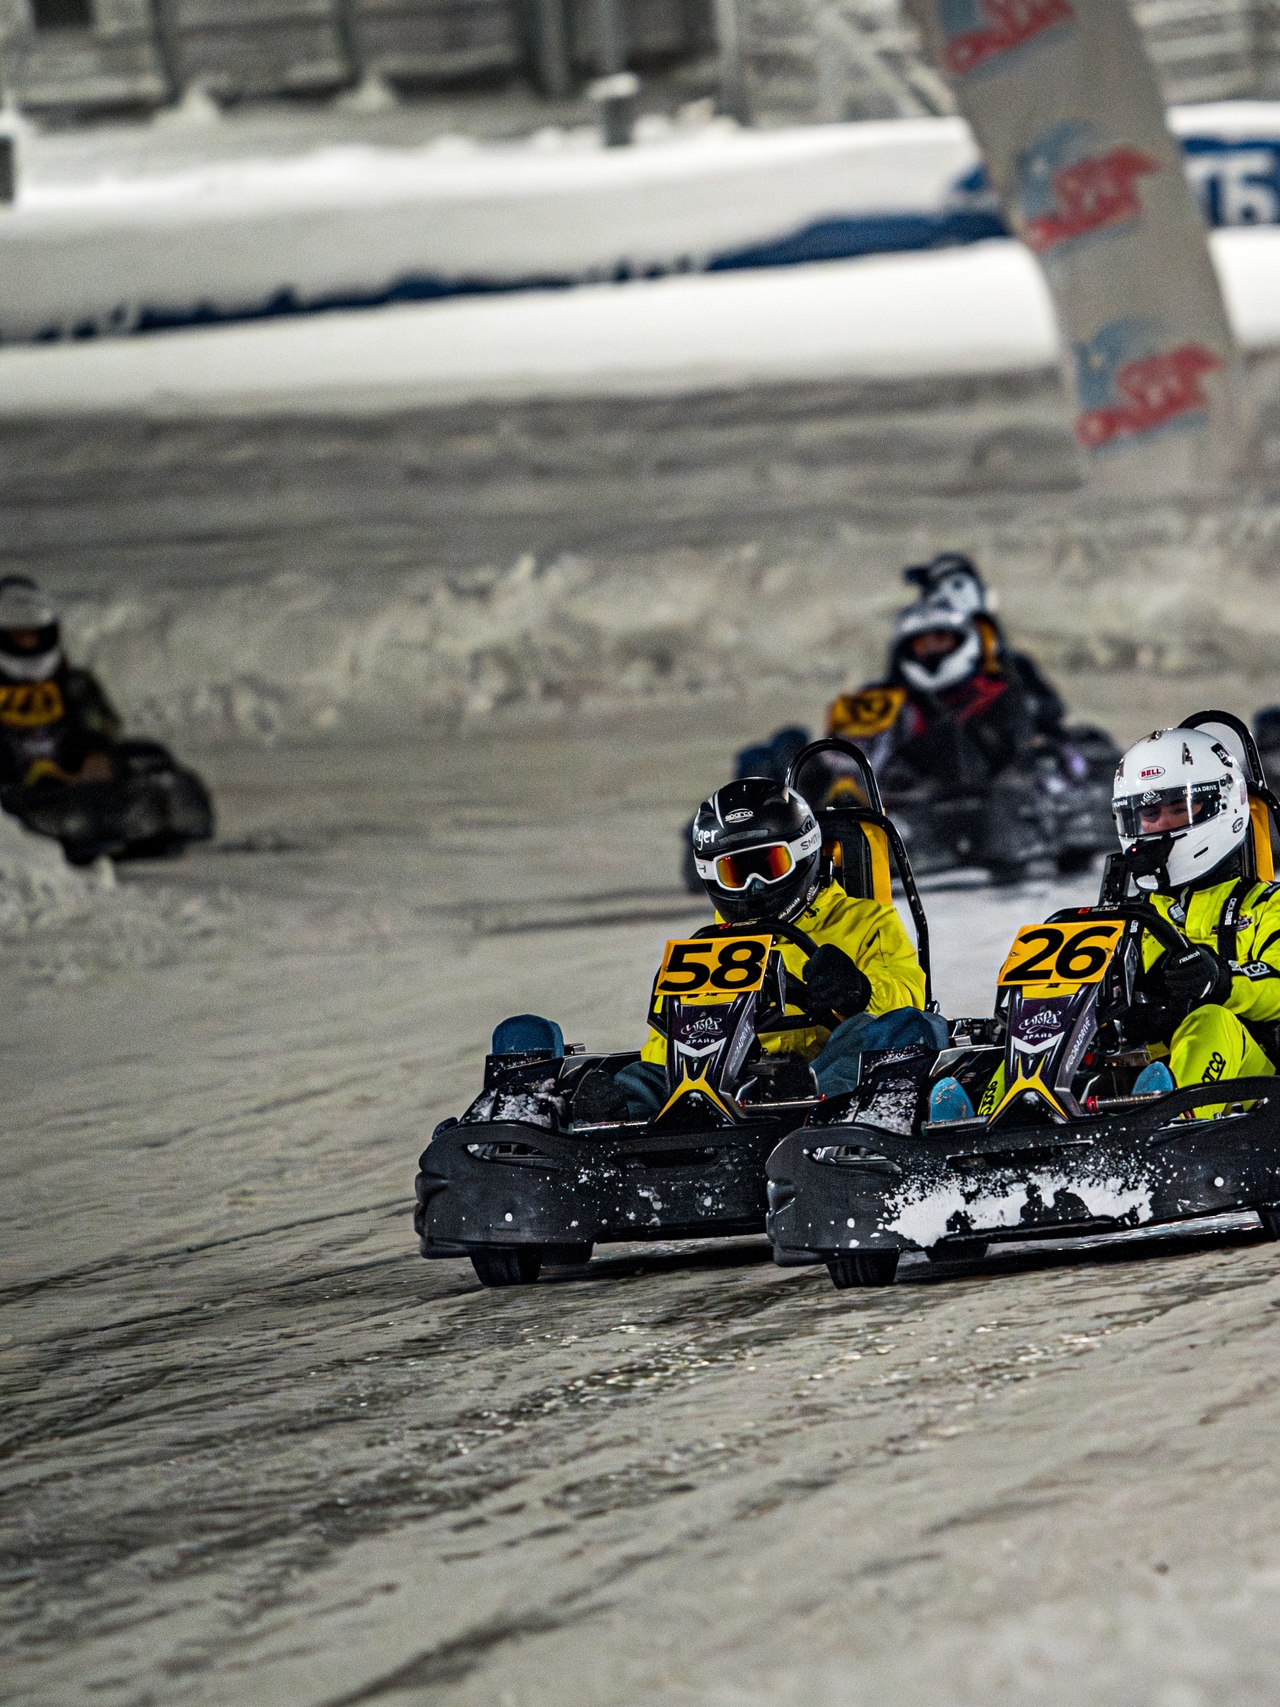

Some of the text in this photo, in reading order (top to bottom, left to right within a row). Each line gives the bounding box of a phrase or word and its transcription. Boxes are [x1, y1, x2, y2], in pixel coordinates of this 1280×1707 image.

[1140, 768, 1163, 778] BELL
[697, 829, 719, 851] ger
[800, 832, 820, 851] SMIT
[658, 940, 766, 992] 58
[1002, 925, 1119, 982] 26
[1201, 1051, 1226, 1083] arco
